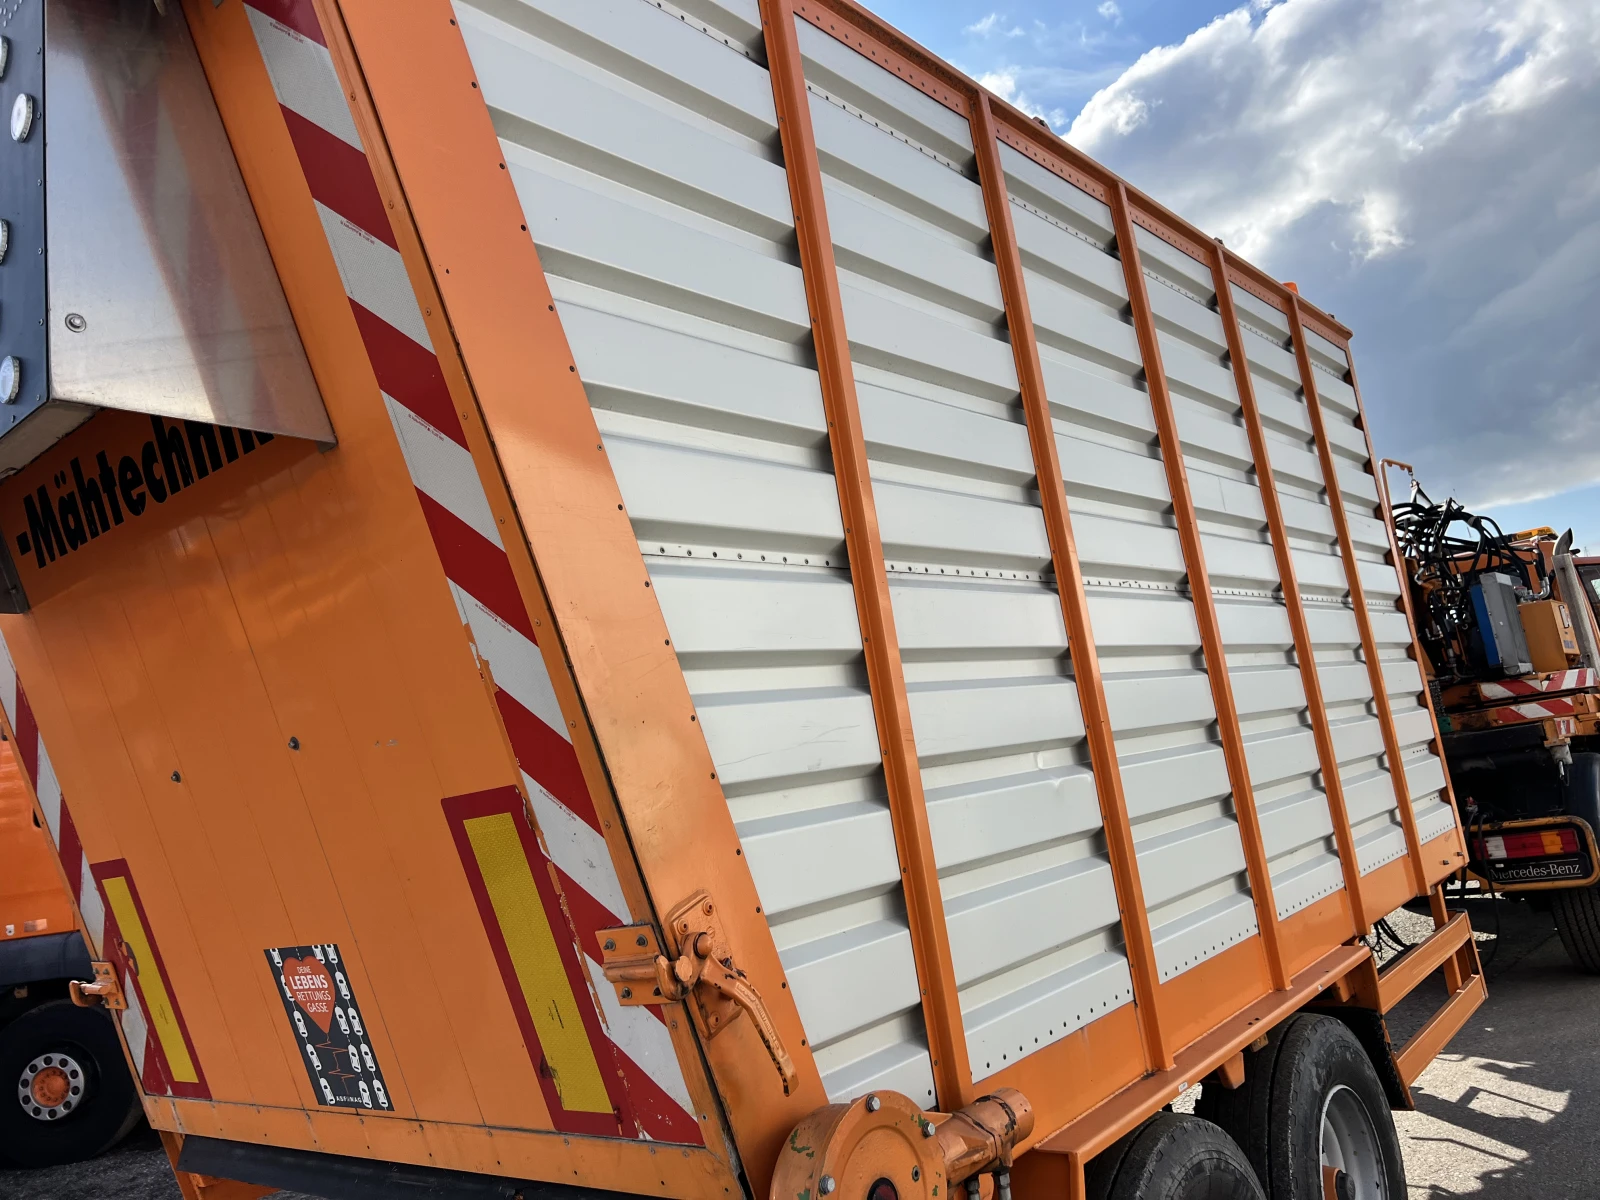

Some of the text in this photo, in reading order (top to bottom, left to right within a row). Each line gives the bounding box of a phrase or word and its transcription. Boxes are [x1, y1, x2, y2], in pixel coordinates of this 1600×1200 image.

[16, 415, 275, 569] -Mähtechn
[1490, 864, 1581, 880] Mercedes-Benz
[297, 966, 312, 974] DEINE
[290, 975, 328, 989] LEBENS
[297, 990, 331, 1001] RETTUNGS
[307, 1003, 329, 1013] GASSE
